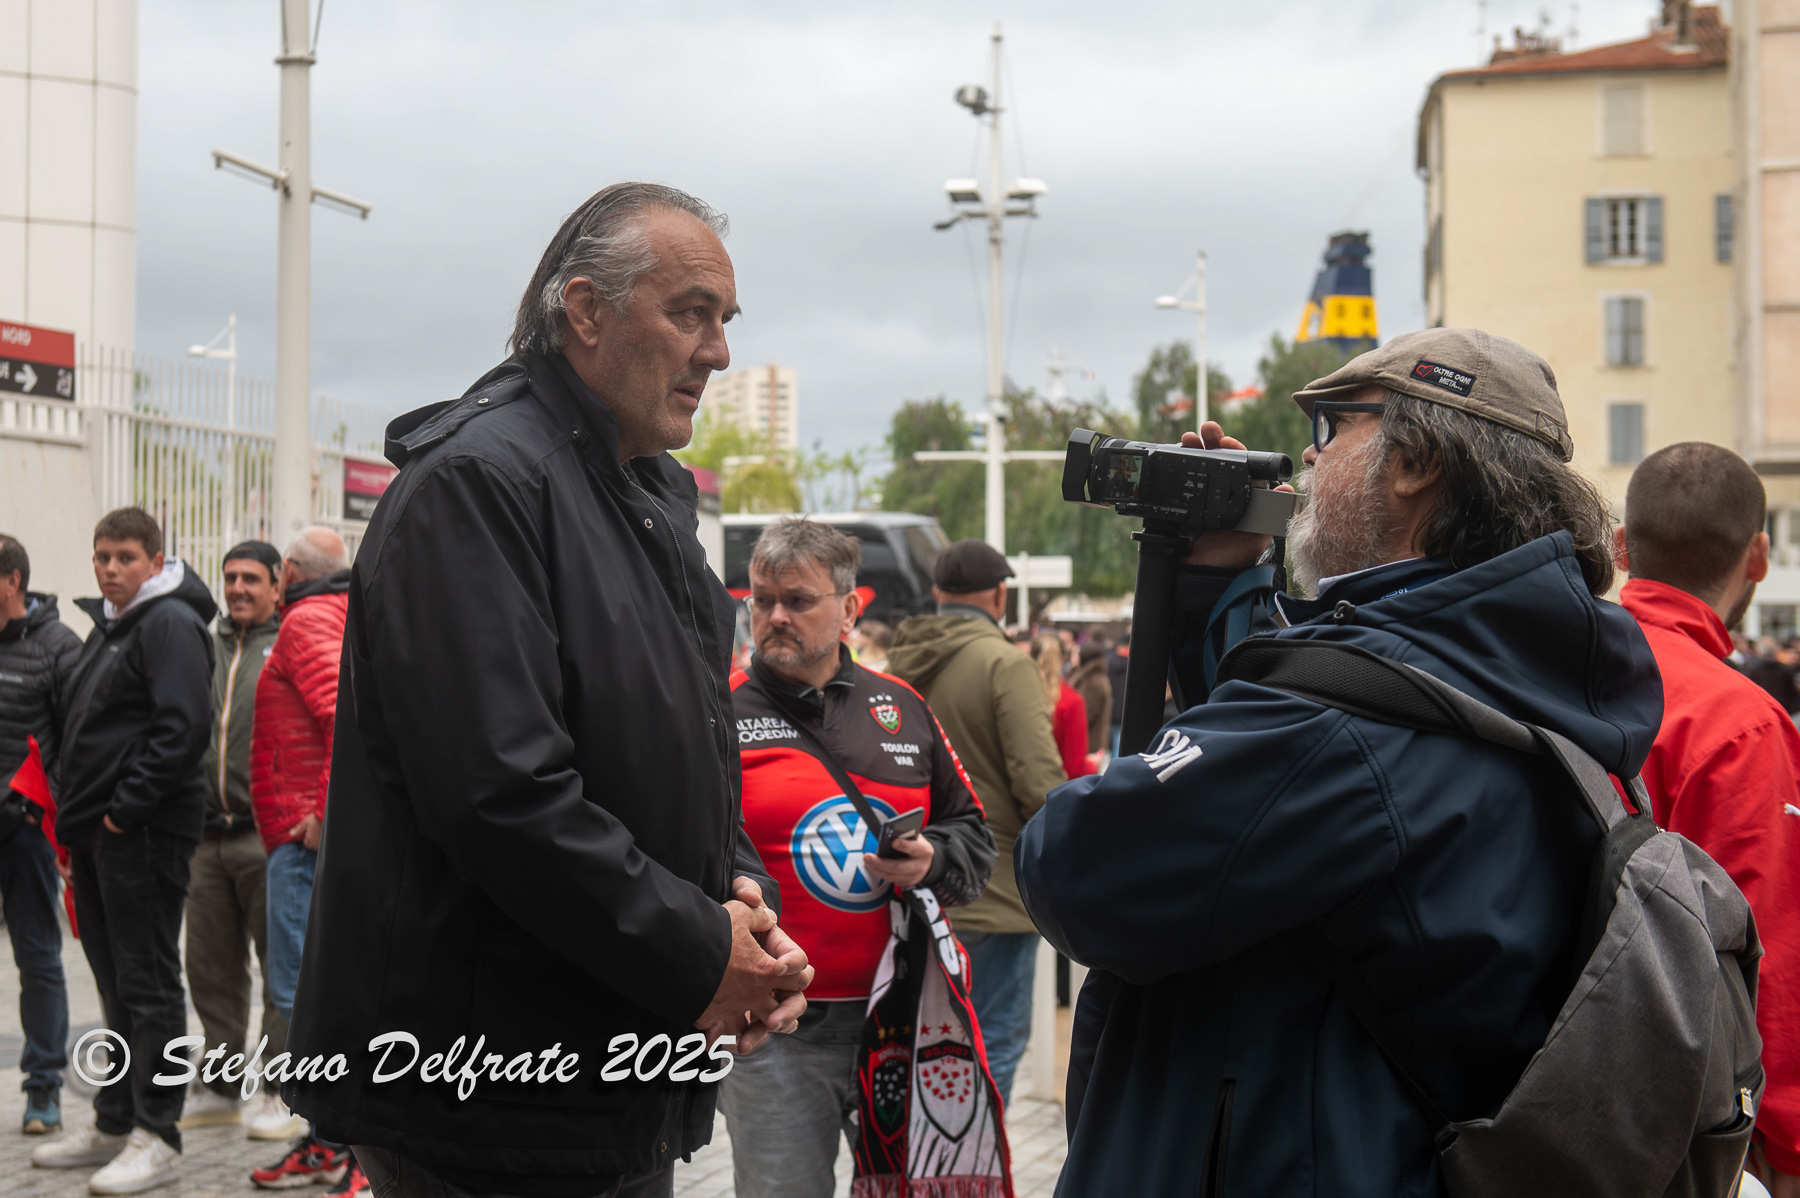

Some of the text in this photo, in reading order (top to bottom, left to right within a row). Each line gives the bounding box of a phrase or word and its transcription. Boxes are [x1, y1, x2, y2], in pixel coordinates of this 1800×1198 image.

[2, 326, 32, 346] NORD
[1434, 366, 1472, 384] OLTRE OGNI
[738, 728, 801, 743] OGEDIM
[880, 742, 920, 754] TOULON
[893, 755, 915, 766] VAR
